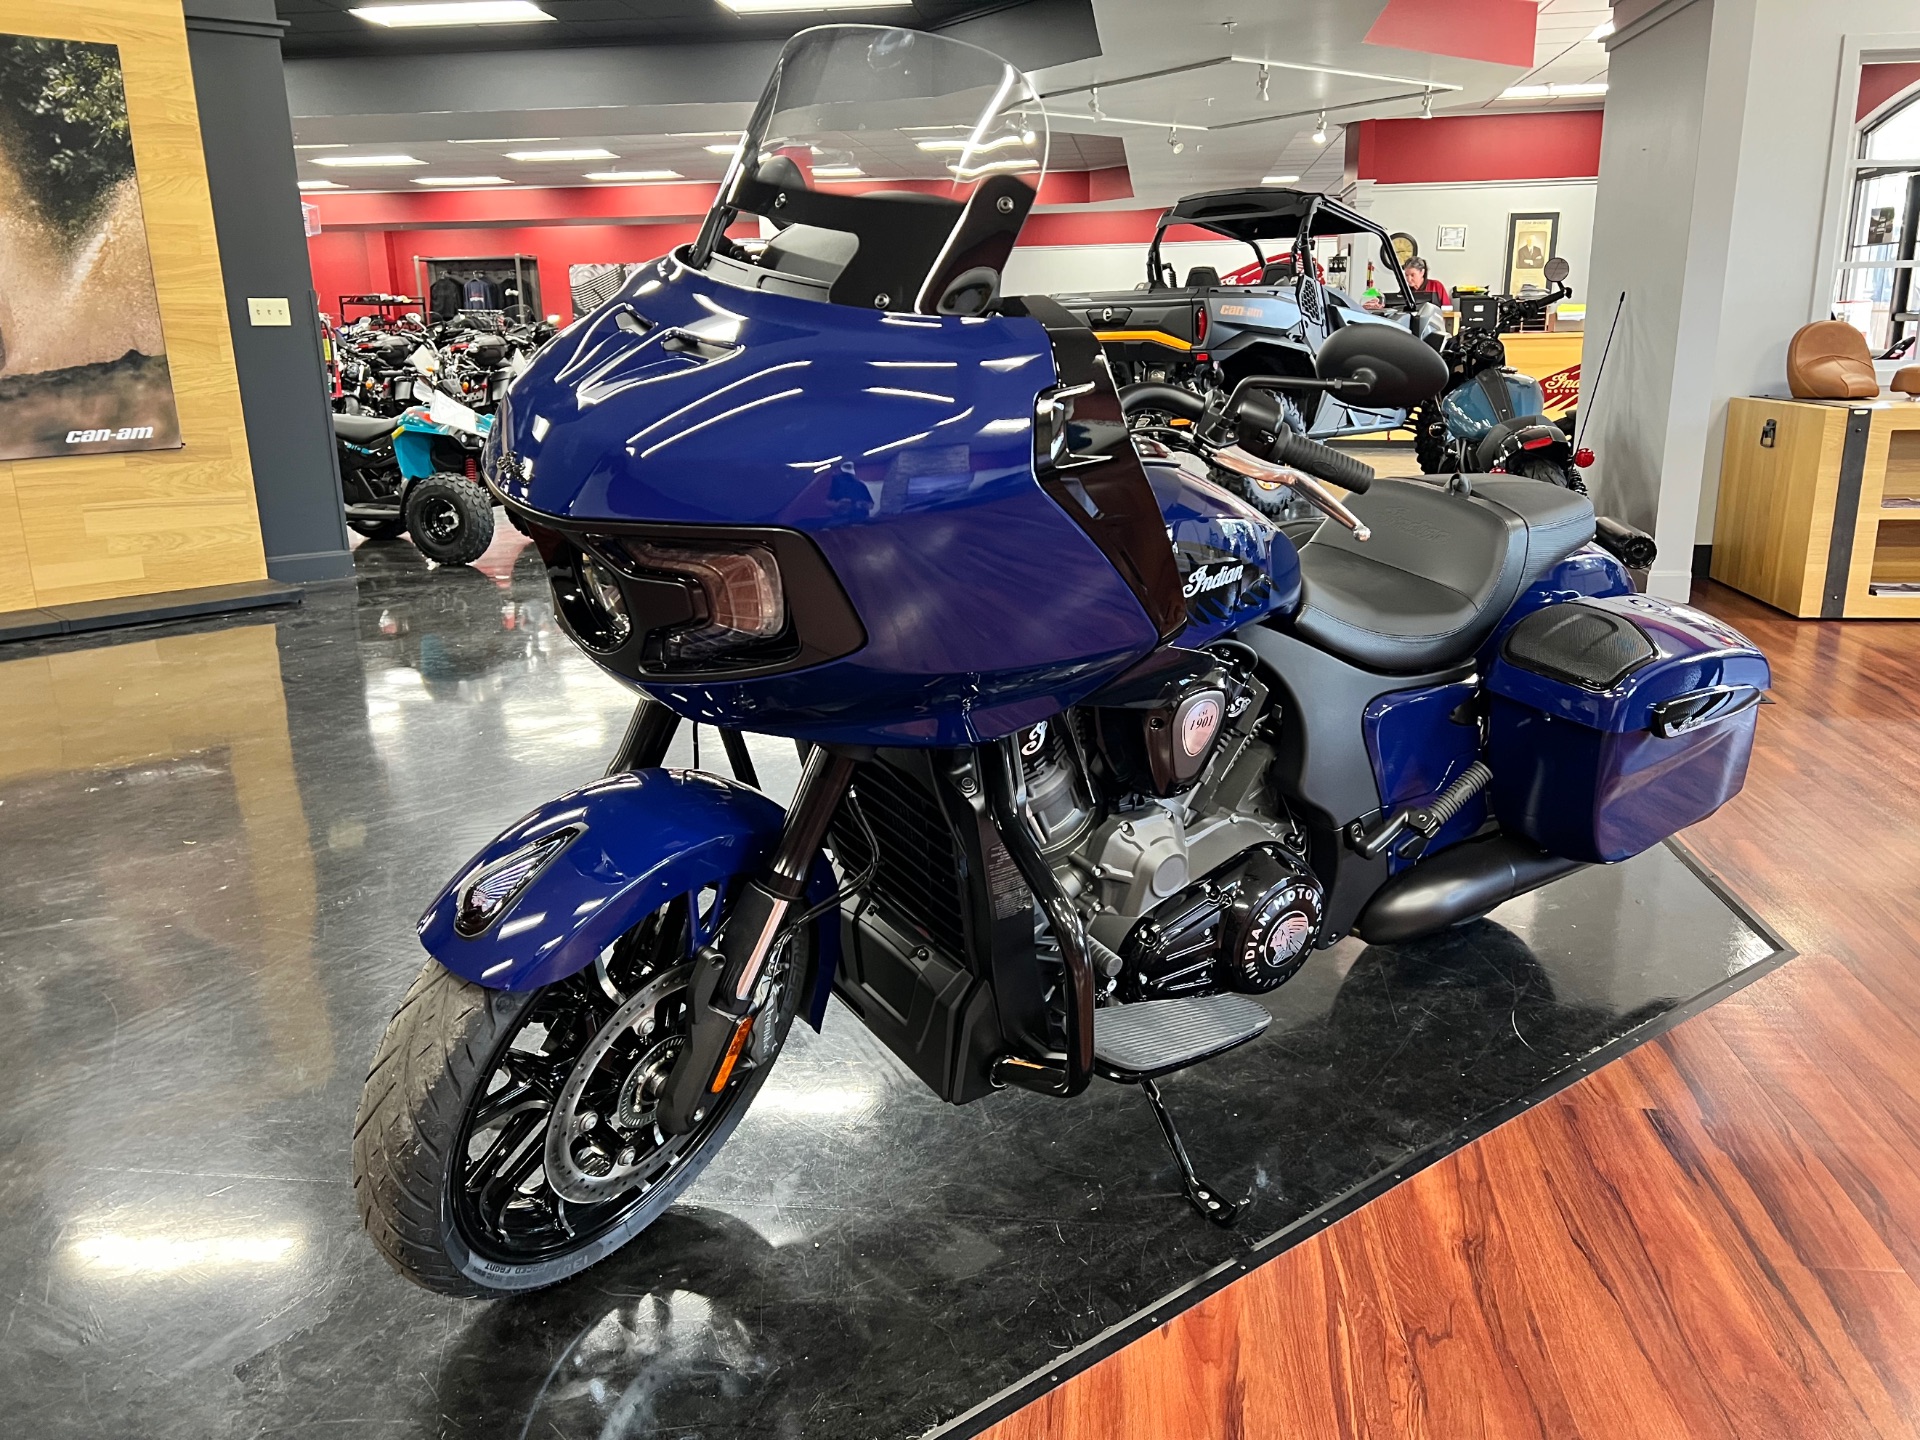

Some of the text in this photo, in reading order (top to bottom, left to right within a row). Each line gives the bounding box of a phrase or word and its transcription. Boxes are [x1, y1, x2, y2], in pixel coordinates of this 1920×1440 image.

[65, 426, 154, 444] can-am
[1182, 564, 1244, 598] Indian
[1189, 715, 1214, 731] 1901
[1244, 887, 1323, 980] INDIAN MOTORCYCLE
[484, 1262, 512, 1275] FRONT
